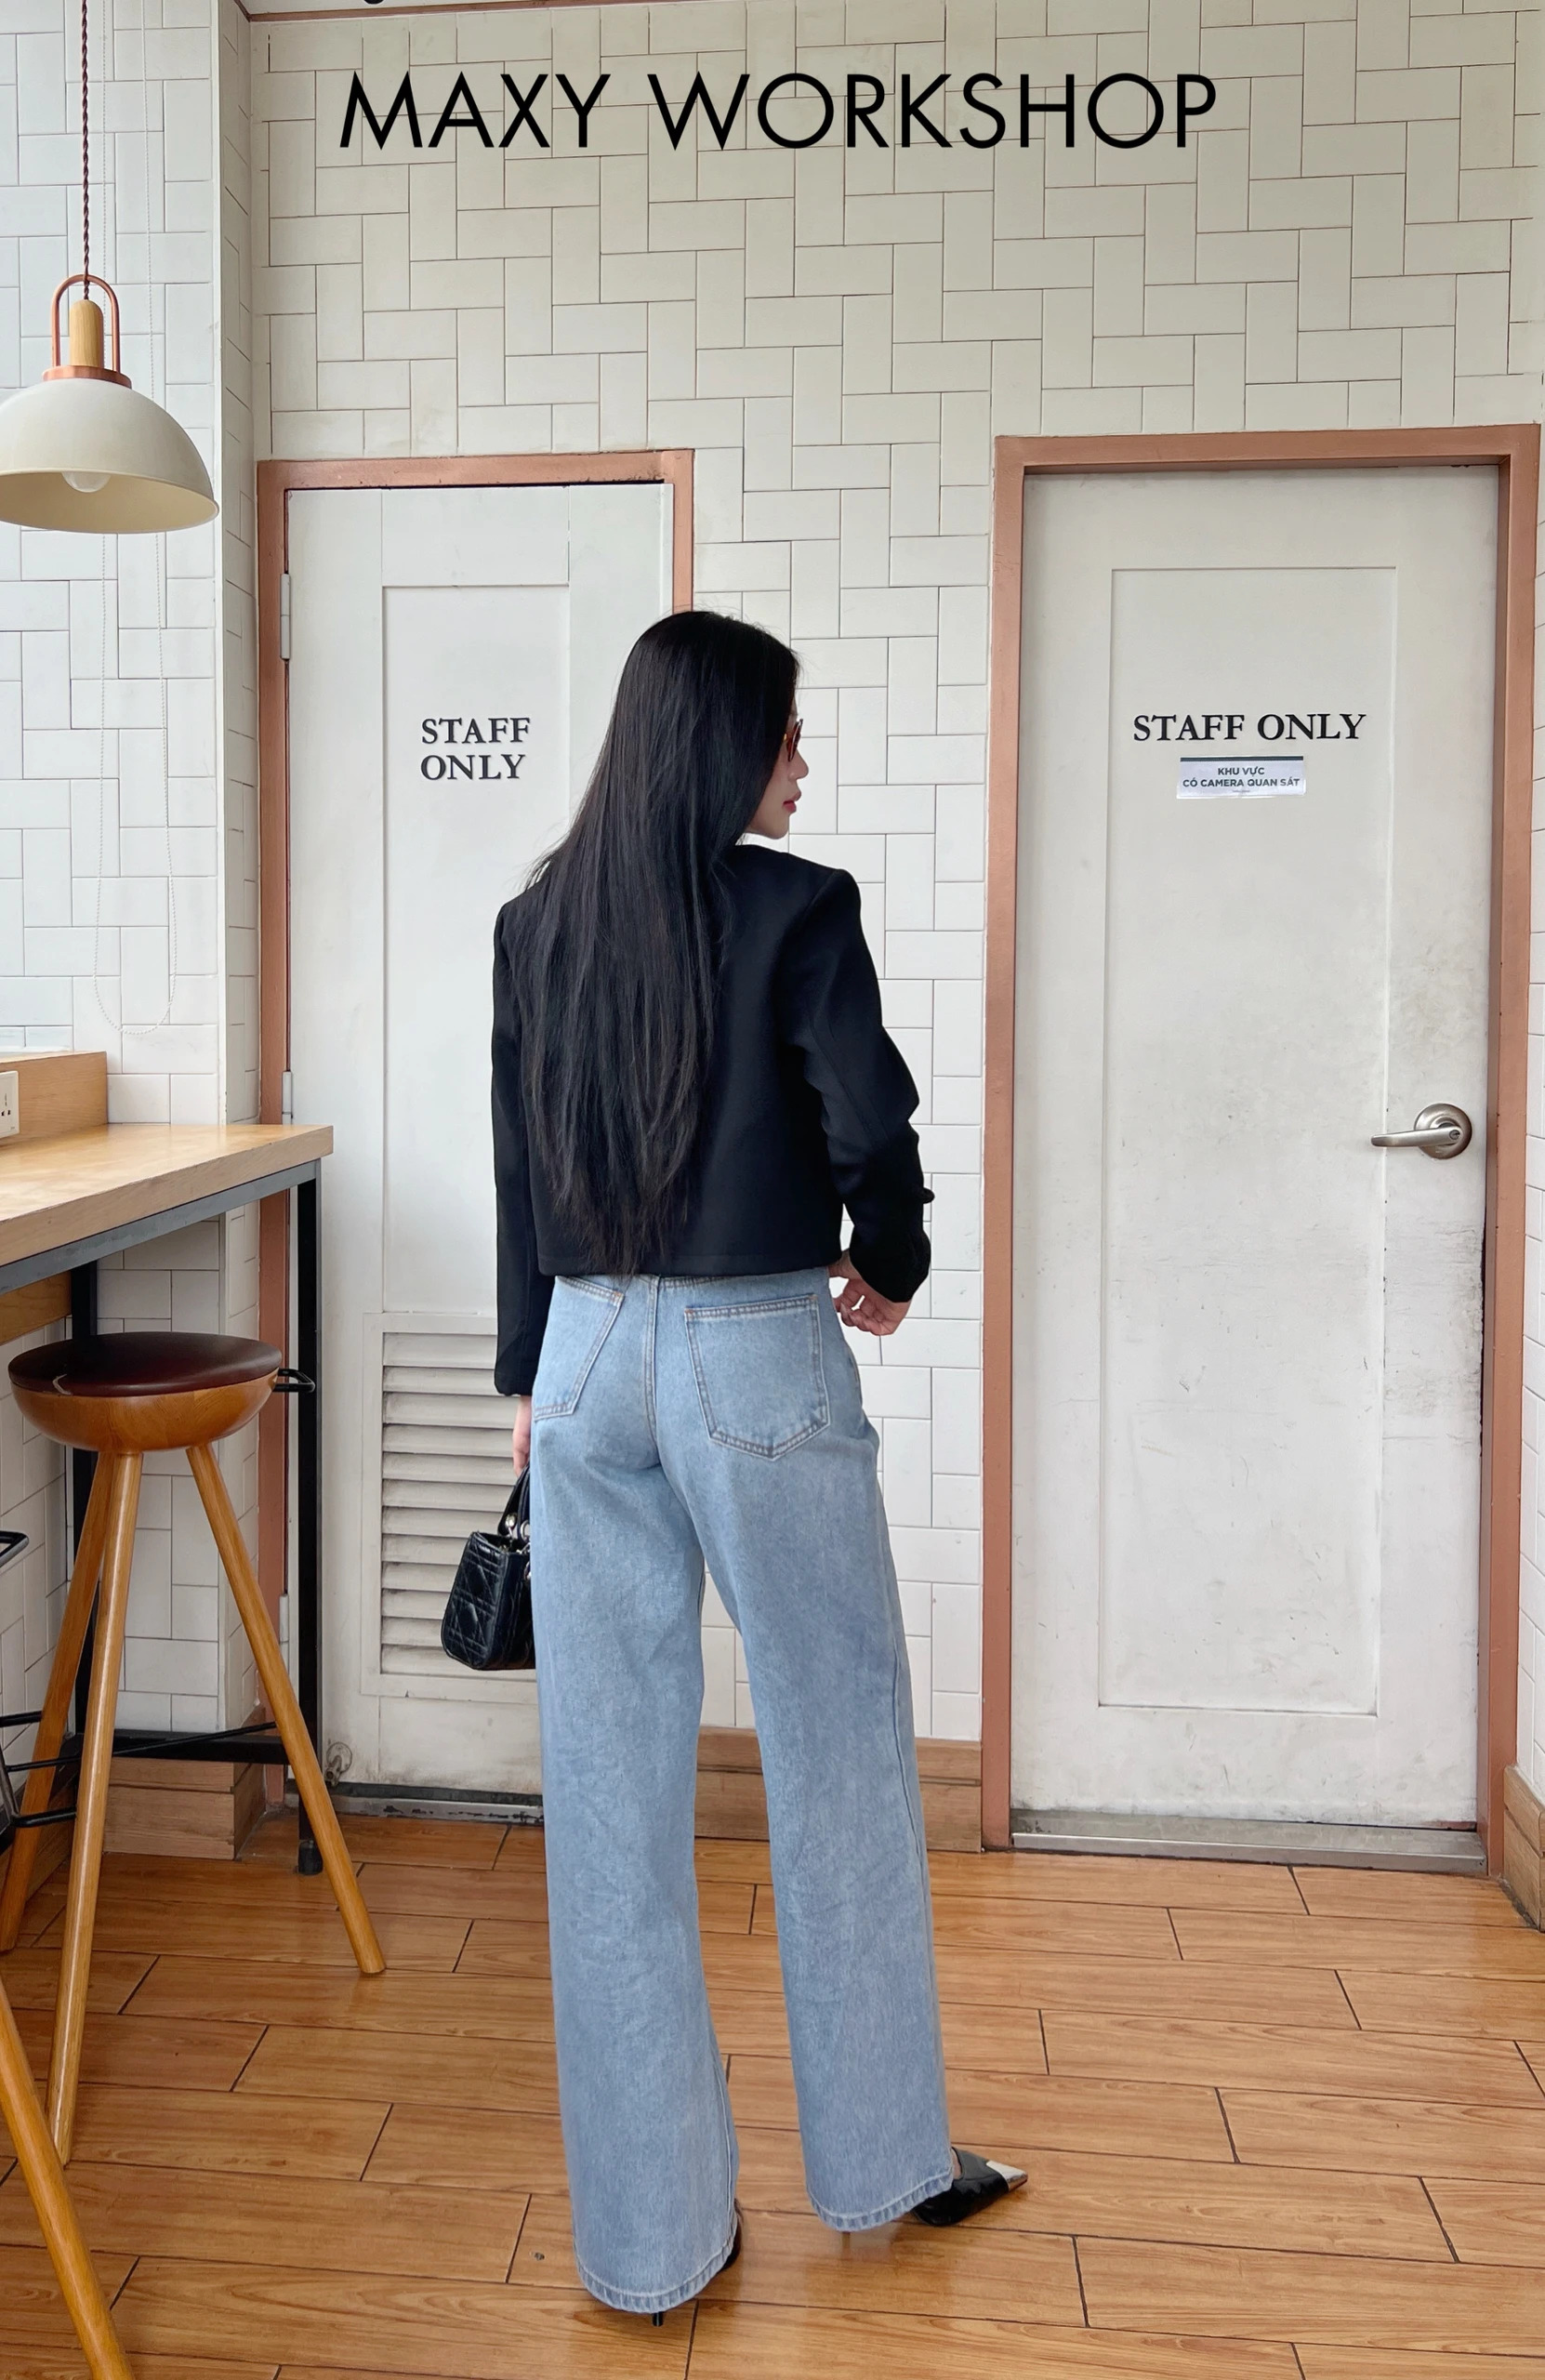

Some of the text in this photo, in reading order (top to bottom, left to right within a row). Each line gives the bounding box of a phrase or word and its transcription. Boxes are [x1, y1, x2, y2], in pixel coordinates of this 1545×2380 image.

[421, 717, 531, 745] STAFF
[1133, 713, 1367, 741] STAFF ONLY
[420, 753, 526, 781] ONLY
[1182, 775, 1301, 787] CÓ CAMERA QUAN SÁT
[1218, 766, 1265, 777] KHU VỰC
